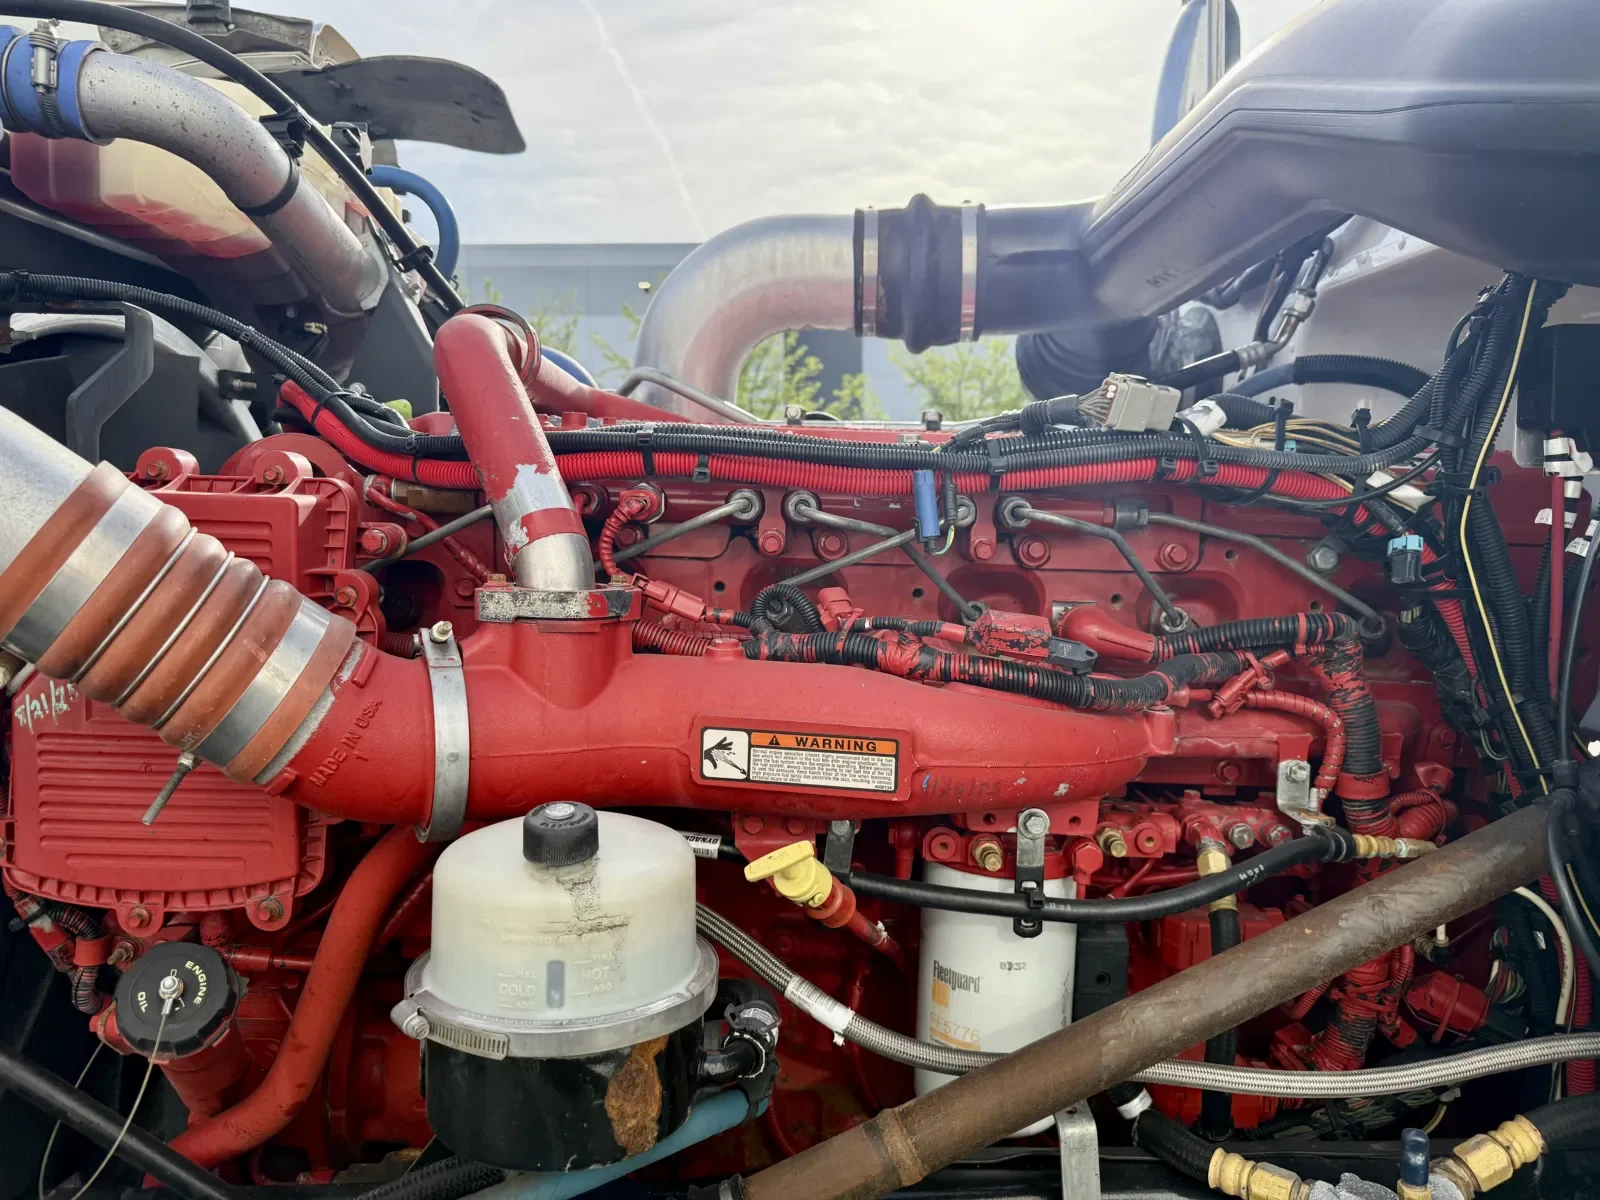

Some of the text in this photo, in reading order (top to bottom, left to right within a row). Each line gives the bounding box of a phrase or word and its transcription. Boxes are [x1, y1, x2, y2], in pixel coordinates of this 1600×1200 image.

[795, 736, 877, 752] WARNING
[309, 747, 348, 787] MADE
[341, 729, 362, 750] IN
[682, 834, 719, 845] DYNACR
[581, 966, 611, 981] HOT
[933, 959, 981, 994] Fleetguard
[137, 960, 207, 1013] ENGINE OIL
[498, 983, 537, 997] COLD
